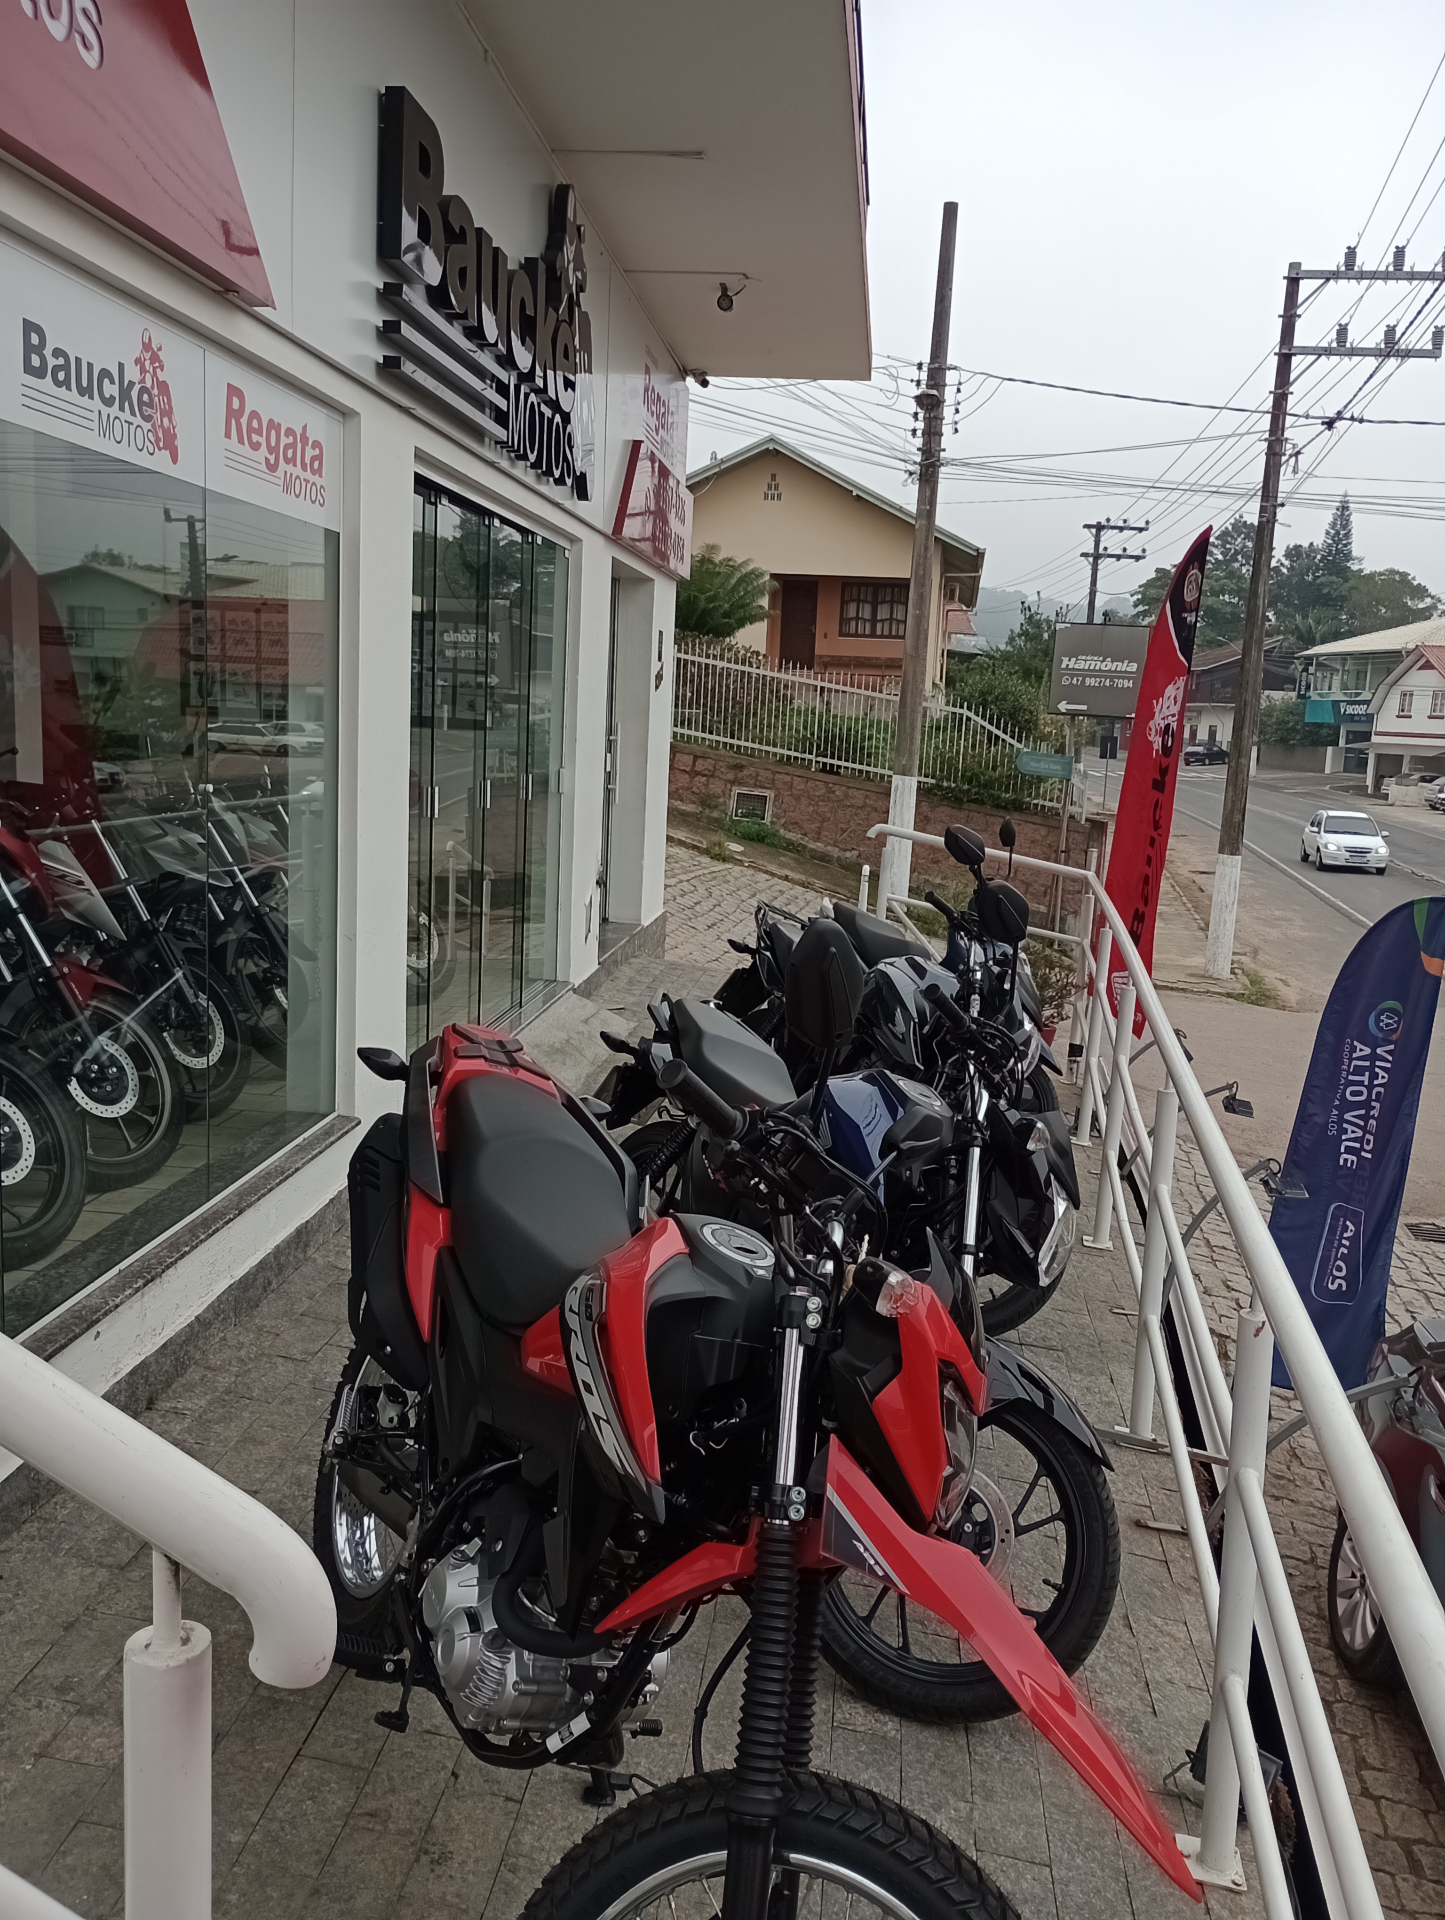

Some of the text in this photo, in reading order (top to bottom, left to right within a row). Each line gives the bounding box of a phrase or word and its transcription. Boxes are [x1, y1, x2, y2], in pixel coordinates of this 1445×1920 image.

[382, 85, 576, 412] Baucke
[21, 317, 155, 424] Baucke
[642, 362, 675, 444] Regata
[97, 408, 156, 456] MOTOS
[224, 382, 324, 479] Regata
[508, 373, 575, 488] MOTOS
[281, 469, 326, 508] MOTOS
[1060, 656, 1138, 672] Hamônia
[1072, 677, 1133, 688] 47 99274-7094
[1327, 1037, 1352, 1137] COOPERATIVA AILOS
[1344, 1039, 1372, 1102] ALTO
[1362, 1043, 1395, 1160] VIACREDI
[1338, 1106, 1370, 1170] VALE
[1328, 1220, 1355, 1291] AILOS
[852, 1539, 886, 1577] ABS
